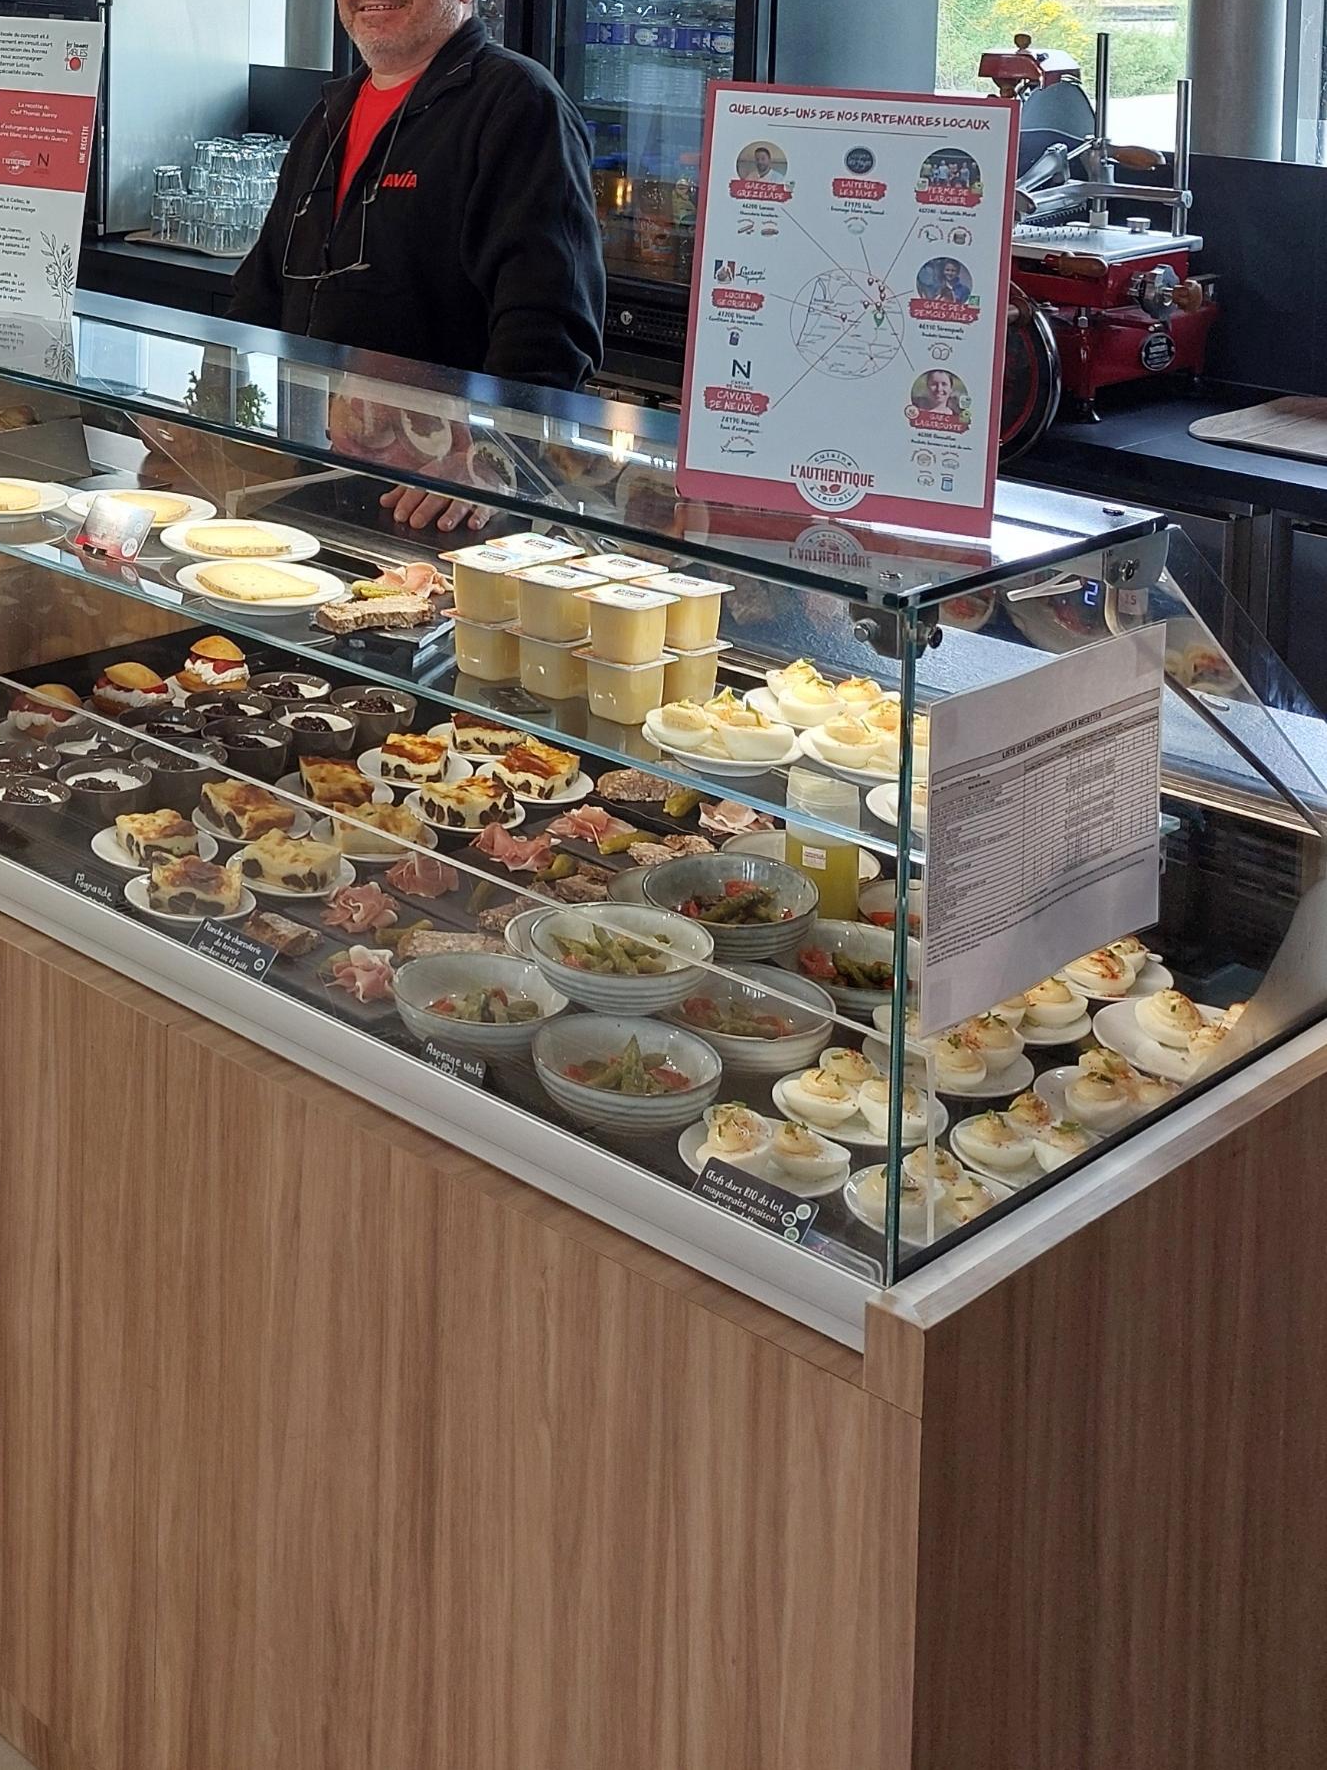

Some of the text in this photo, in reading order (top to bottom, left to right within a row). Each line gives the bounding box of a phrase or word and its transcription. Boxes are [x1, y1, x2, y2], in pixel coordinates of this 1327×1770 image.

[728, 103, 991, 131] QUELQUES-UNS DE NOS PARTENAIRES LOCAUX
[731, 358, 752, 379] N
[716, 391, 752, 404] CAVIAR
[790, 463, 875, 488] L'AUTHENTIQUE
[702, 1183, 747, 1210] mayonnaise
[747, 1204, 777, 1225] maison
[724, 1178, 743, 1195] durs
[743, 1186, 758, 1201] BIO
[757, 1194, 769, 1207] du
